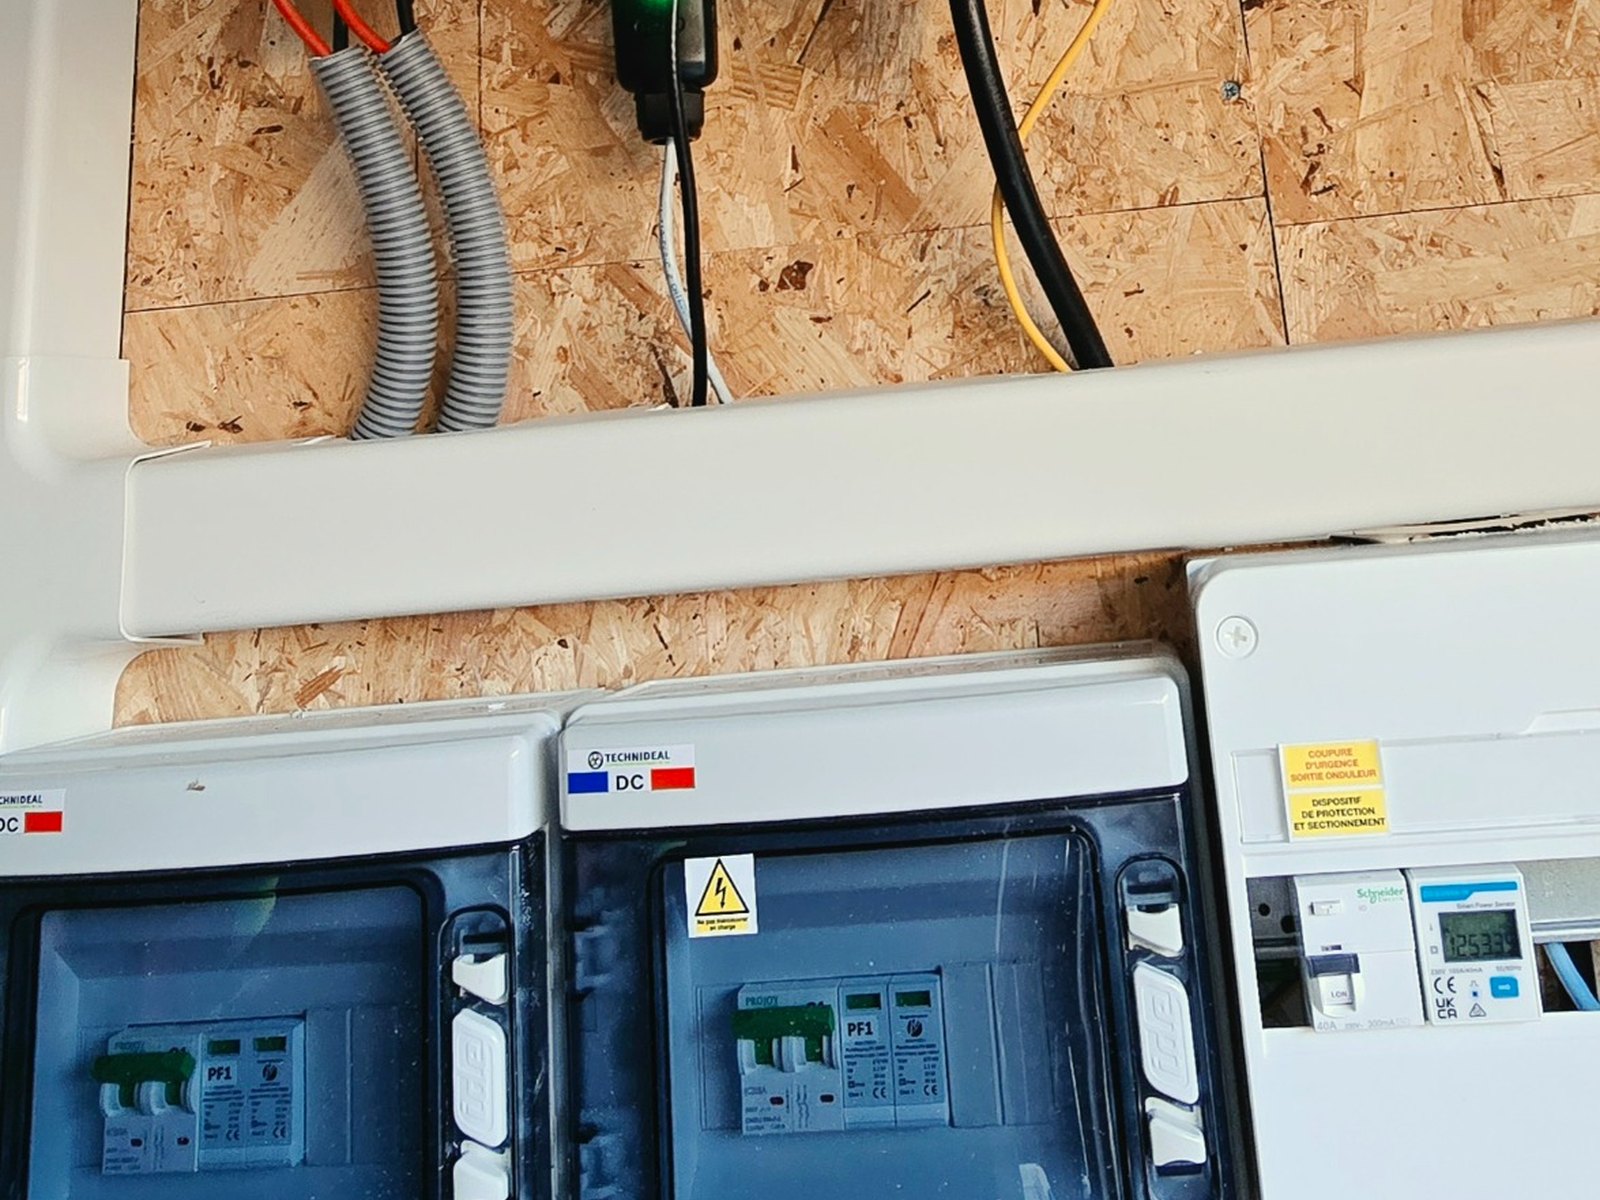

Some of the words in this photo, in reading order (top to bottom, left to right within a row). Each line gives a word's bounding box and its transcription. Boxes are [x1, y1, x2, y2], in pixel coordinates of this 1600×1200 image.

[605, 751, 670, 762] TECHNIDEAL
[1308, 748, 1353, 758] COUPURE
[1305, 759, 1359, 770] D'URGENCE
[1290, 773, 1324, 782] SORTIE
[1326, 769, 1377, 779] ONDULEUR
[616, 774, 644, 790] DC
[1312, 796, 1362, 807] DISPOSITIF
[1301, 810, 1315, 819] DE
[1316, 807, 1375, 818] PROTECTION
[1294, 822, 1305, 831] ET
[1307, 817, 1386, 830] SECTIONNEMENT
[1356, 887, 1404, 904] Schneider
[1434, 976, 1457, 994] CE
[745, 996, 779, 1007] PROJOY
[1436, 998, 1455, 1008] UK
[1437, 1008, 1458, 1019] CA
[848, 1021, 874, 1037] PF1
[1317, 1021, 1337, 1031] 40A
[208, 1066, 232, 1081] PF1
[873, 1087, 887, 1099] CE
[924, 1085, 938, 1096] CE
[226, 1129, 240, 1141] CE
[273, 1127, 286, 1138] CE
